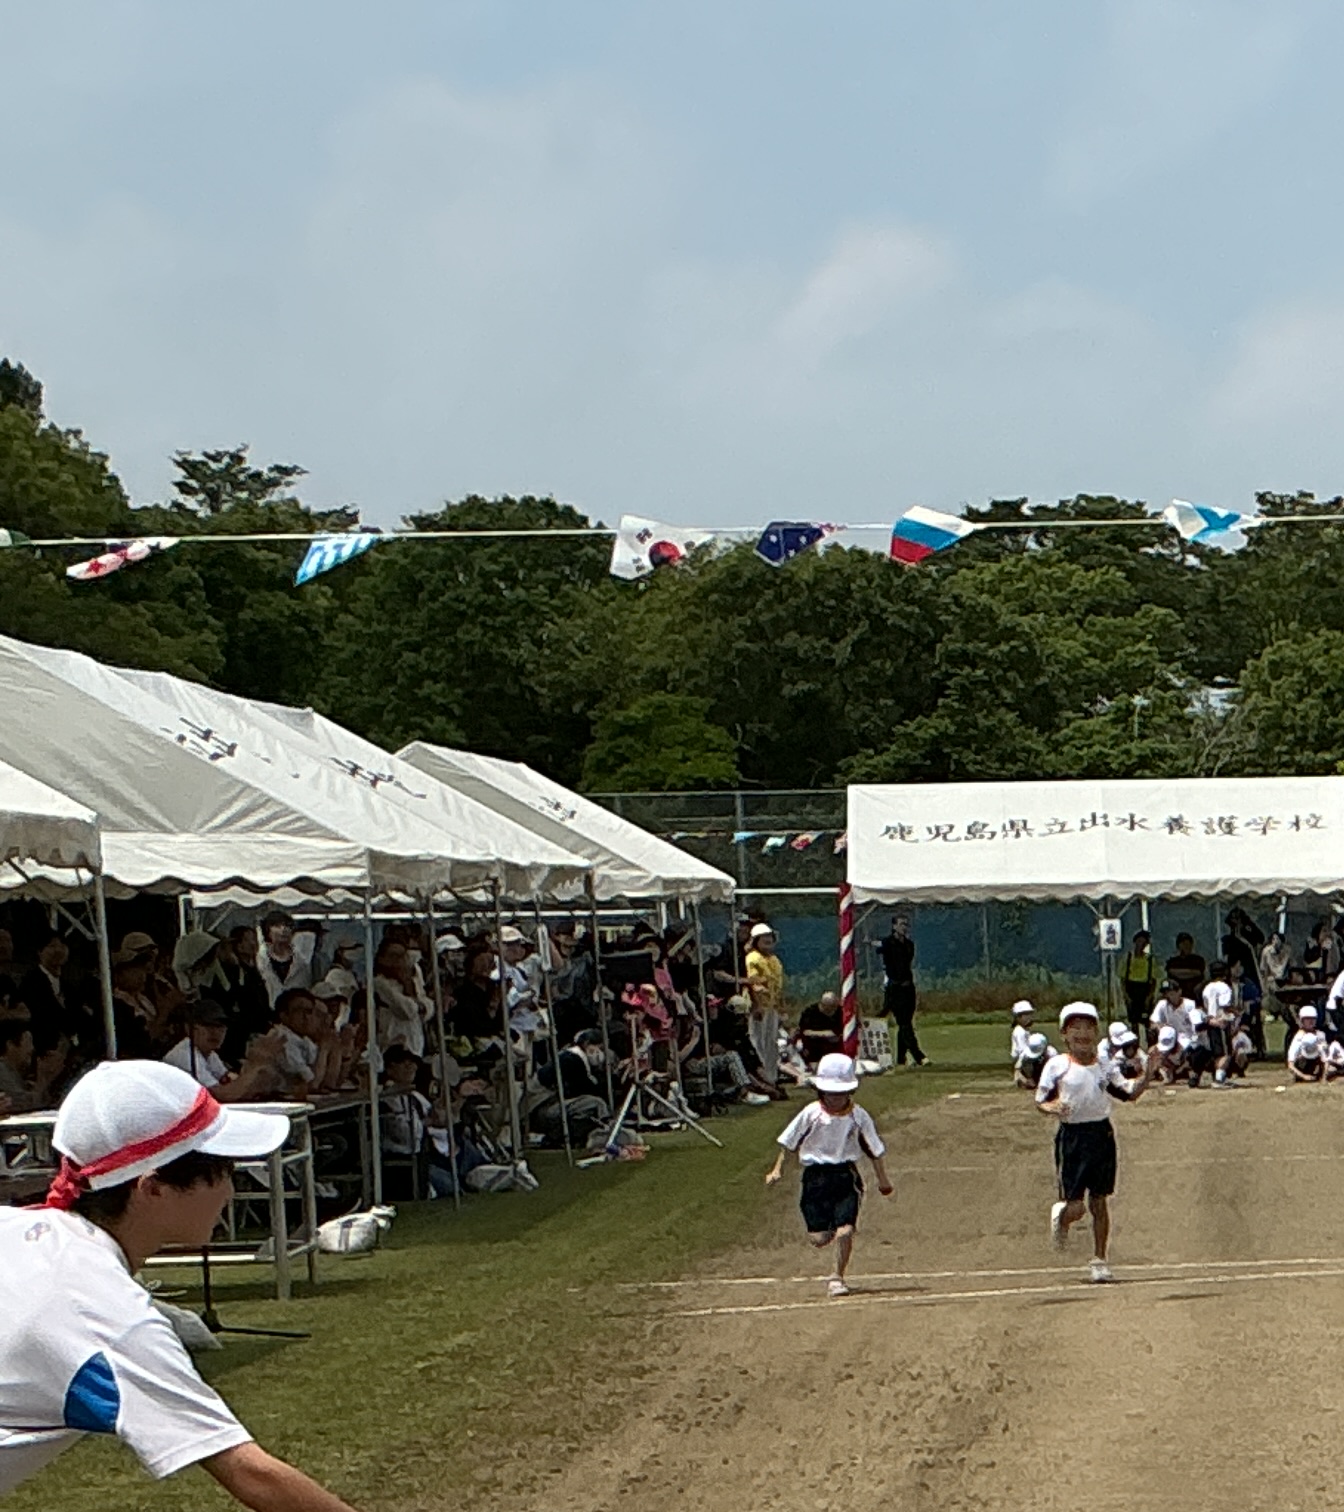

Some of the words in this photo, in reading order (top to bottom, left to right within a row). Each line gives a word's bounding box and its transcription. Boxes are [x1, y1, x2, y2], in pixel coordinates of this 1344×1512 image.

[879, 811, 1329, 843] 鹿児島県立出水養護学校
